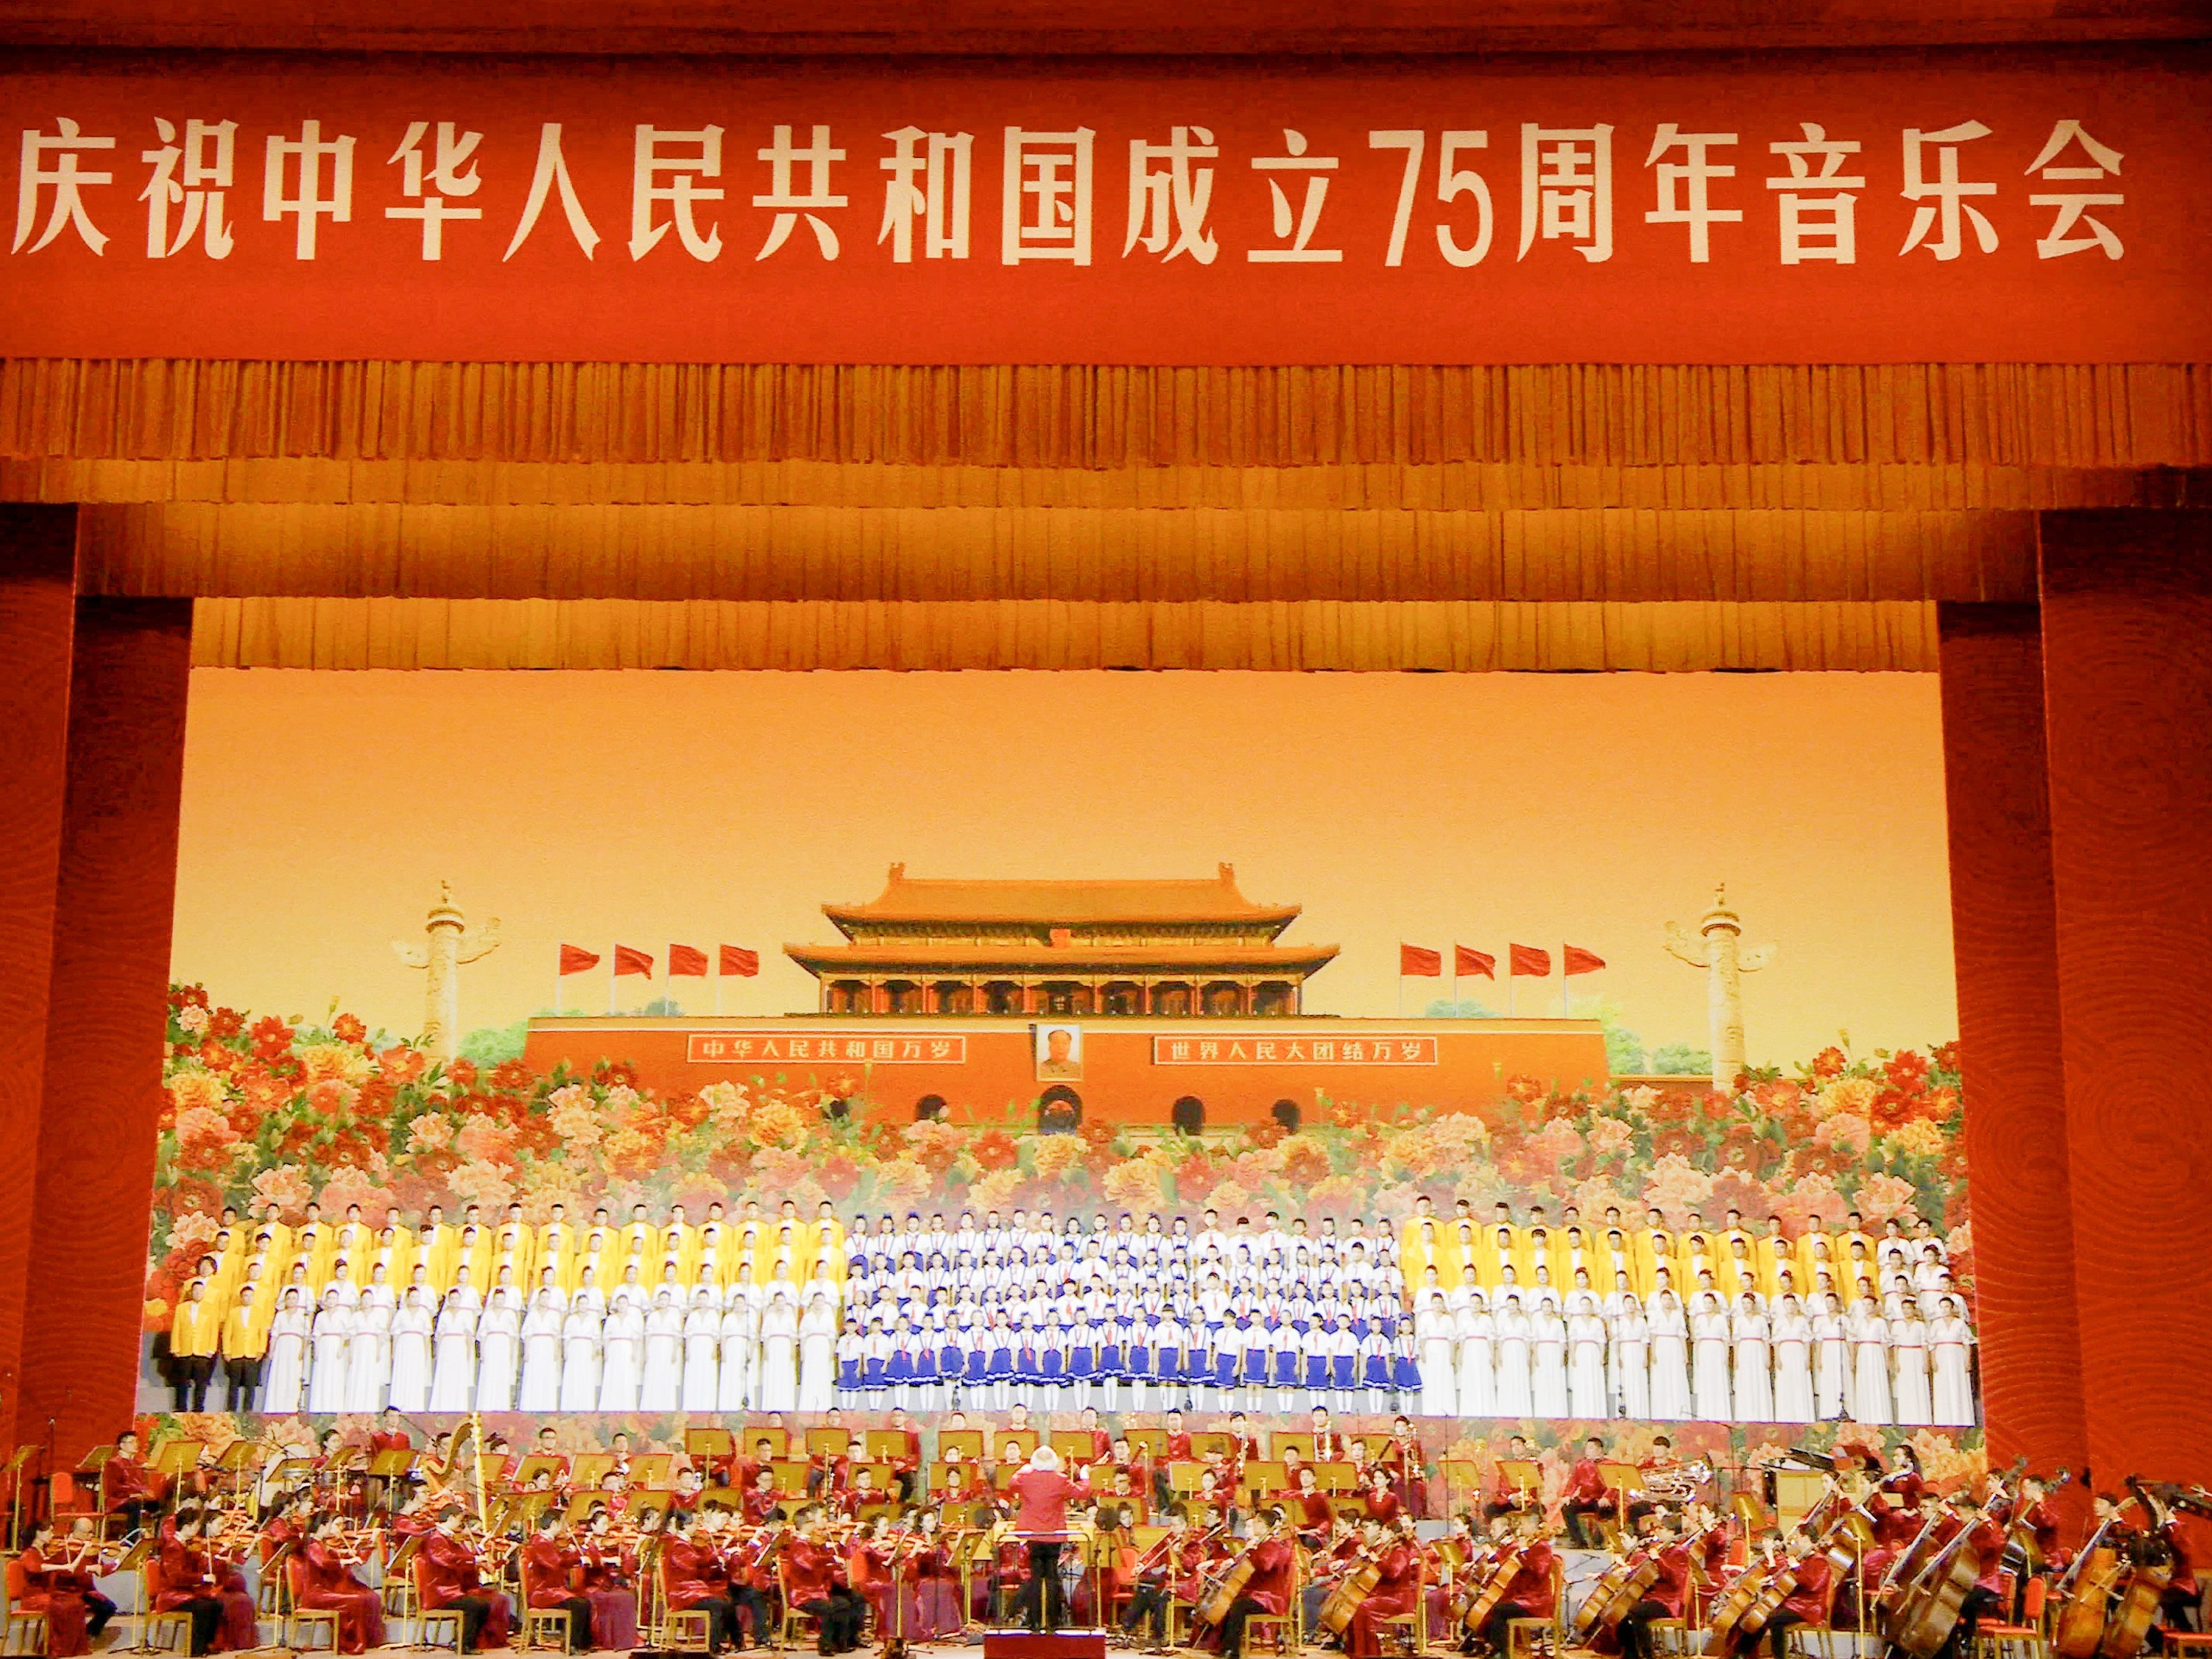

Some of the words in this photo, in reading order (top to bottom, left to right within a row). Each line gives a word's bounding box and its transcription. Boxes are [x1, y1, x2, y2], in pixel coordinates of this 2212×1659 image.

[10, 116, 2125, 267] 庆祝中华人民共和国成立75周年音乐会
[703, 1039, 951, 1058] 中华人民共和国万岁
[1171, 1041, 1422, 1061] 世界人民大团结万岁
